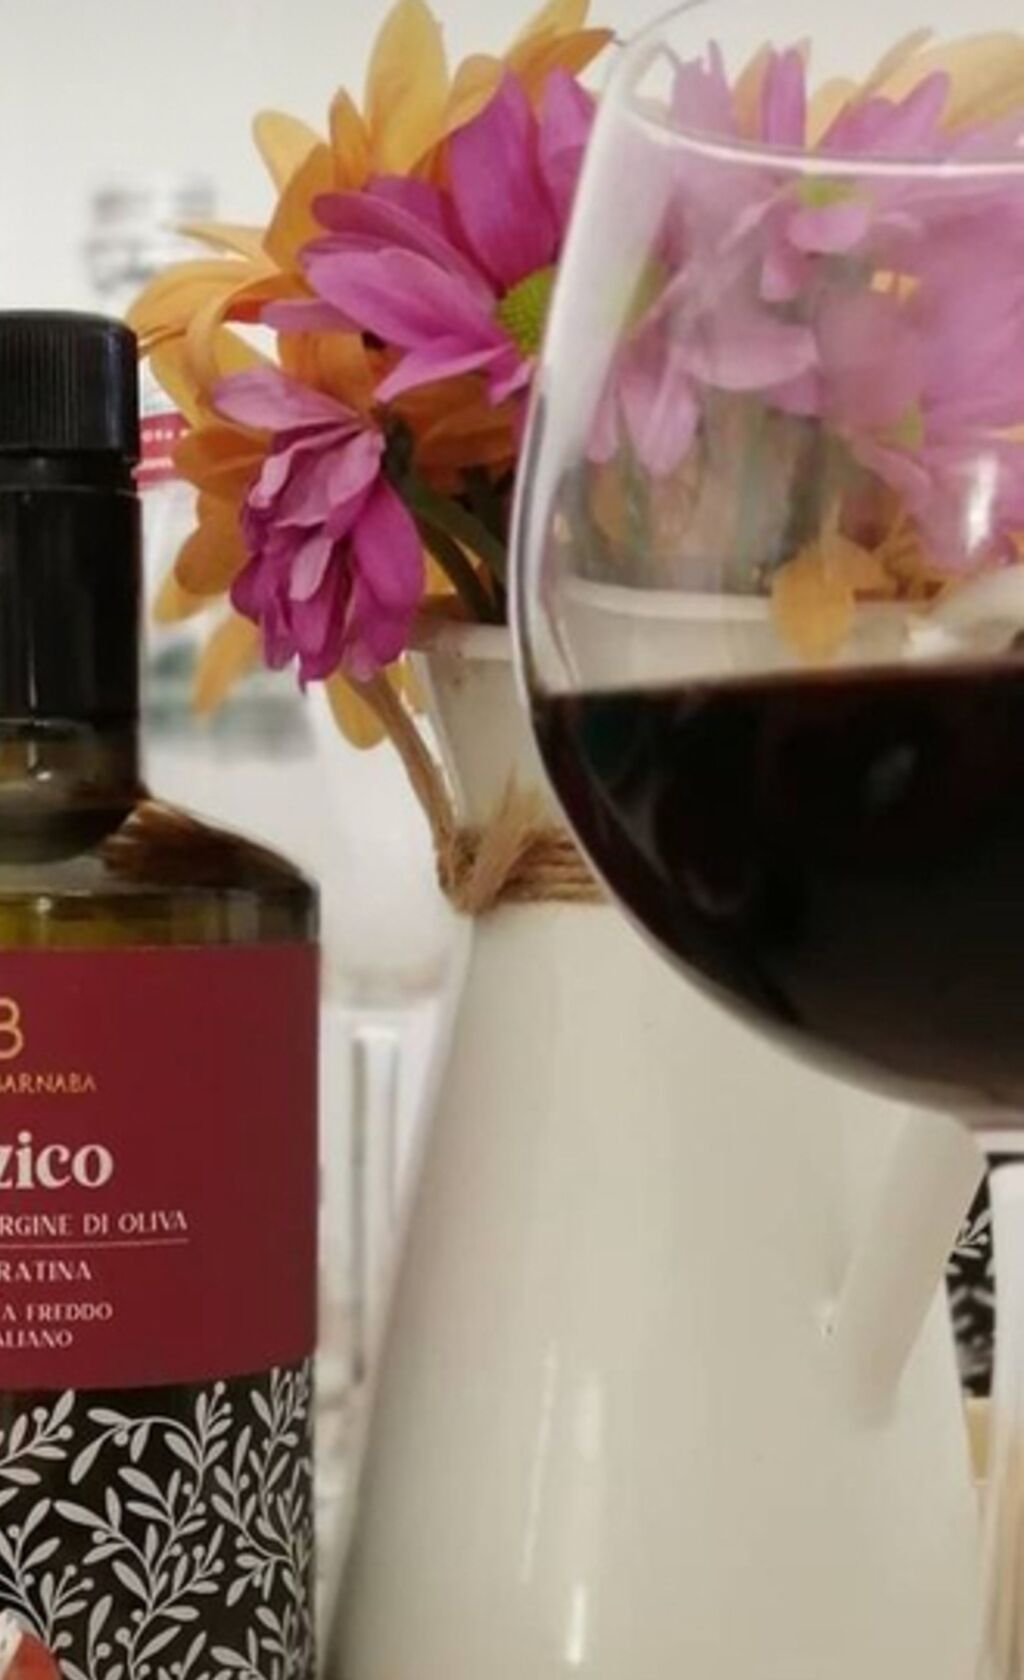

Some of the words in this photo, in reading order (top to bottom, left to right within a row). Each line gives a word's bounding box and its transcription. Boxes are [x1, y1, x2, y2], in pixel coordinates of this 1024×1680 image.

[83, 1213, 109, 1235] DI
[118, 1210, 189, 1233] OLIVA
[1, 1303, 17, 1322] A
[26, 1302, 114, 1322] FREDDO
